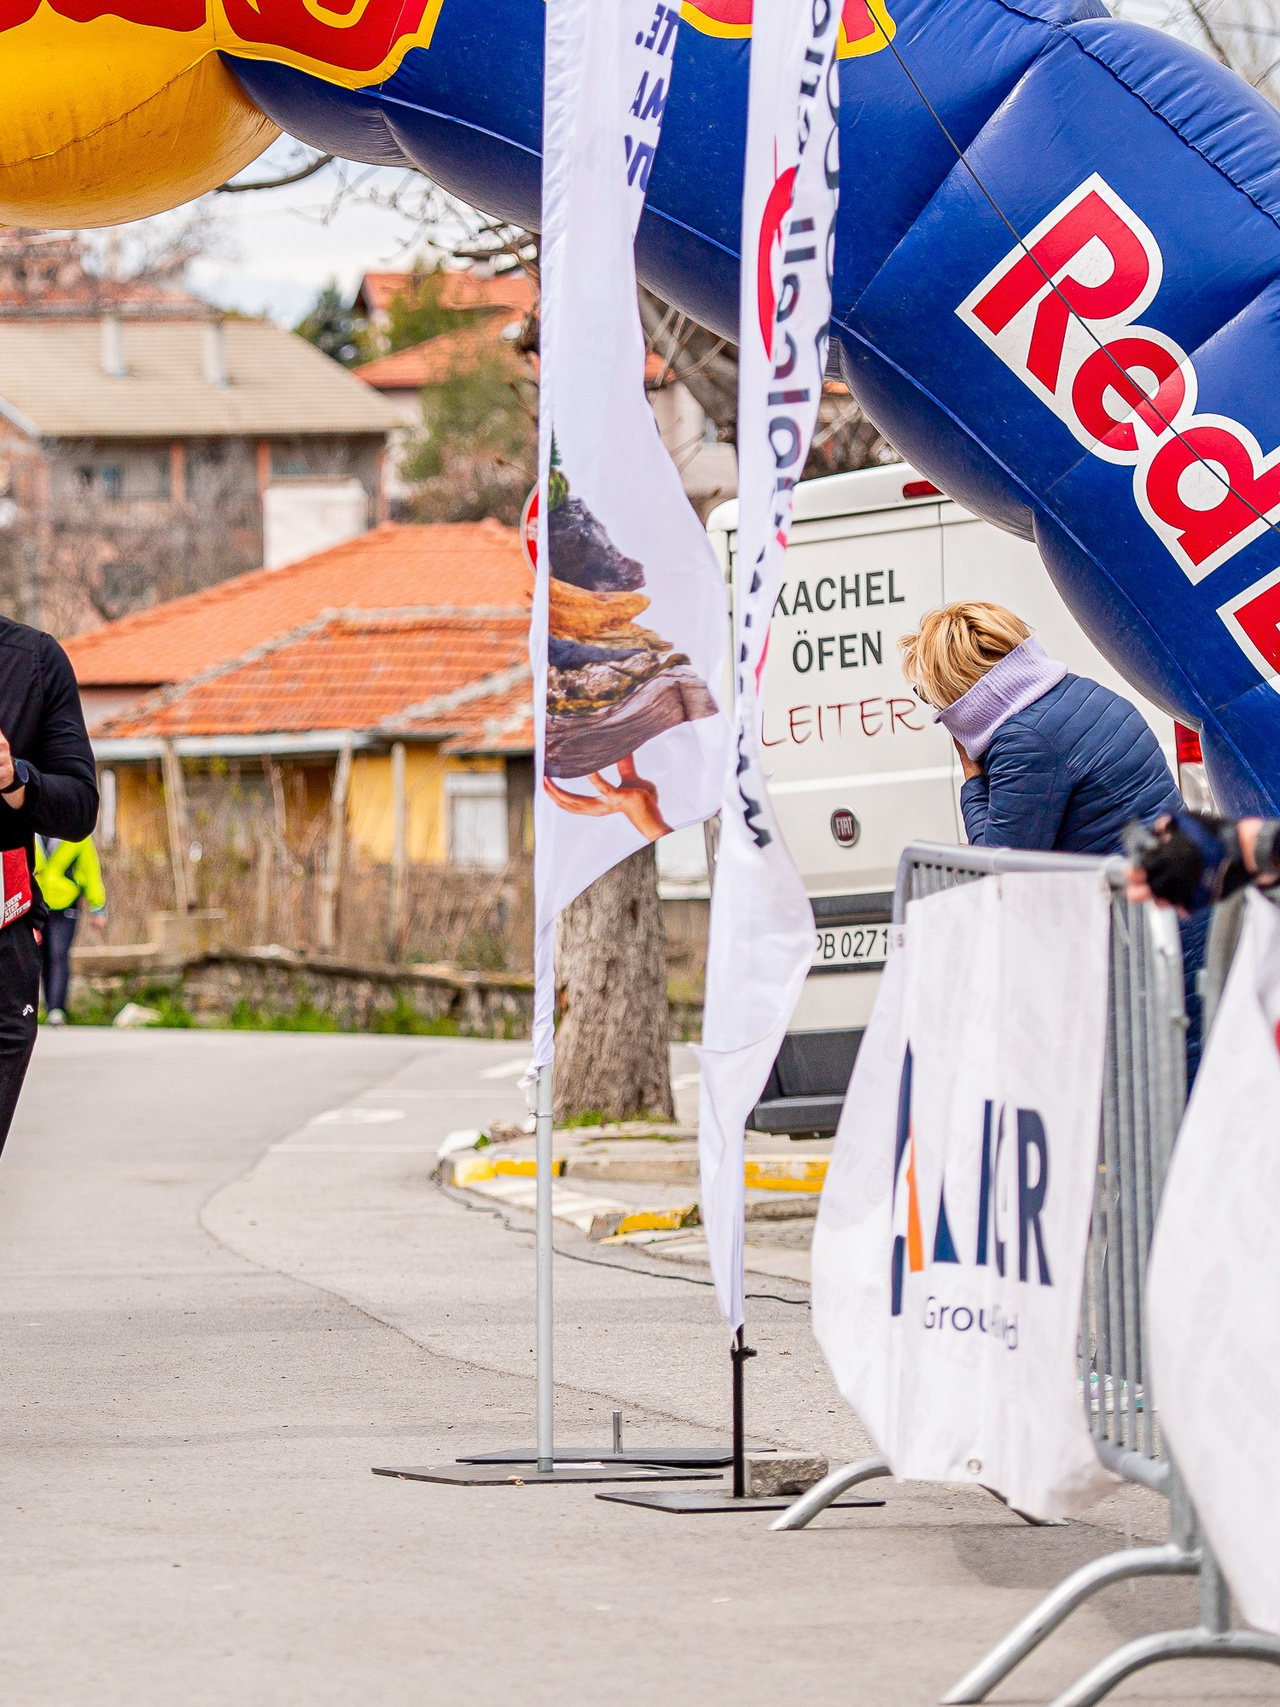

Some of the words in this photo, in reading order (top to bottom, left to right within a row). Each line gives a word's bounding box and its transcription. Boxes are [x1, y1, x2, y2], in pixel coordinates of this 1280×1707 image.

[964, 180, 1280, 576] Red
[771, 569, 906, 618] KACHEL
[792, 630, 883, 673] ÖFEN
[761, 697, 926, 747] LEITER
[835, 816, 854, 836] FIAT
